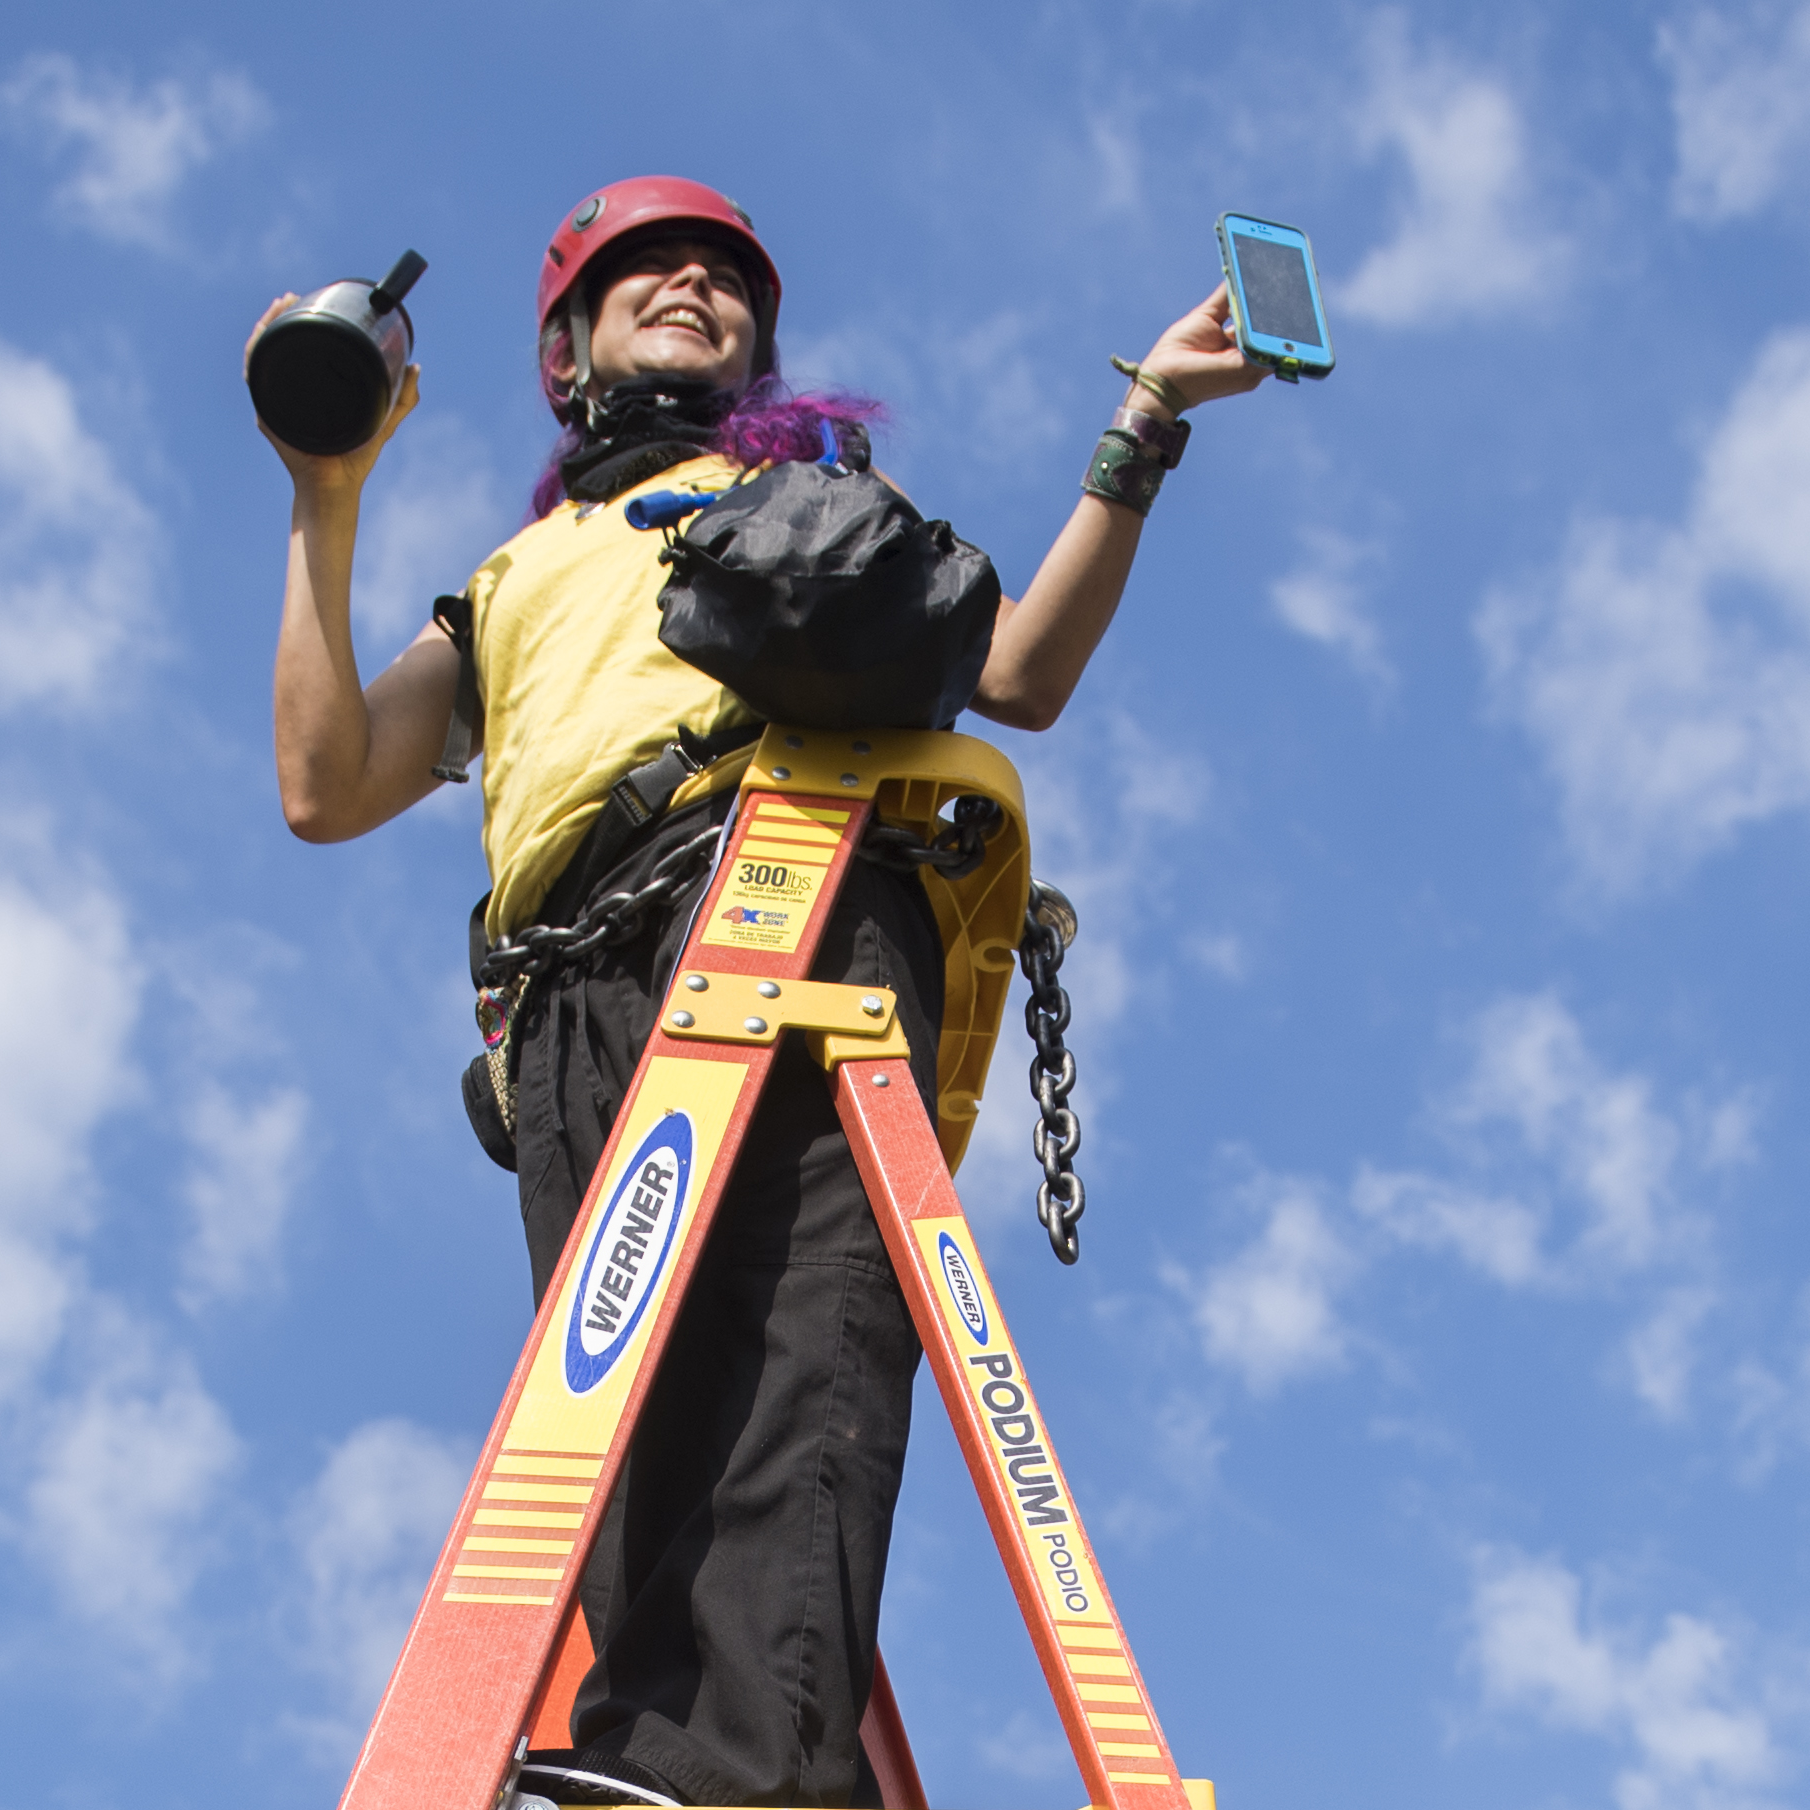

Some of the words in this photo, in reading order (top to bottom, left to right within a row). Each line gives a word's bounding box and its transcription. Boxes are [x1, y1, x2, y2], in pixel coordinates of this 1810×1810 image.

[744, 884, 764, 892] LOAD
[766, 886, 803, 896] CAPACITY
[585, 1161, 675, 1334] WERNER
[946, 1253, 982, 1325] WERNER
[969, 1353, 1069, 1527] PODIUM
[1043, 1533, 1089, 1612] PODIO
